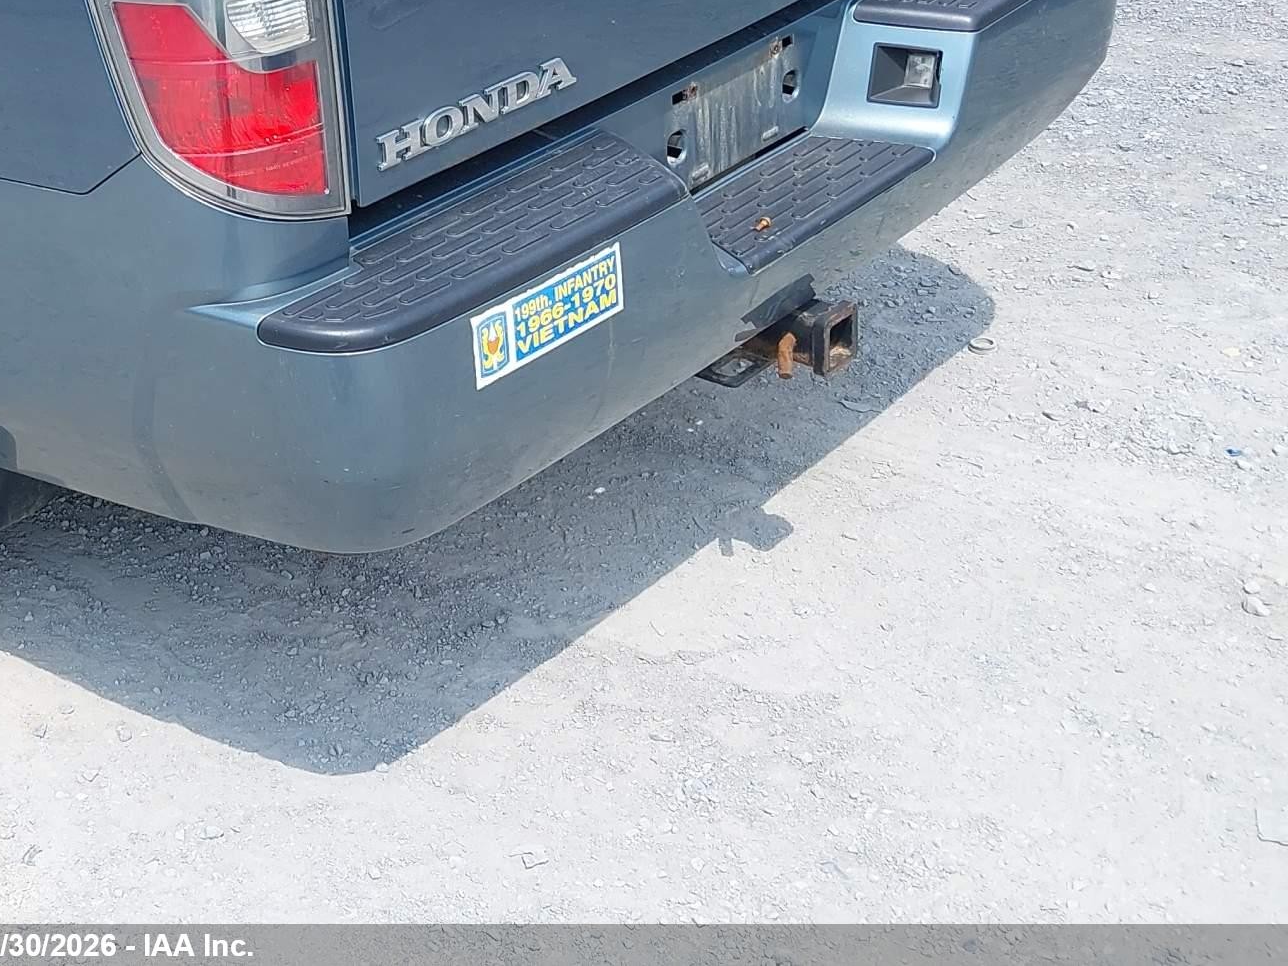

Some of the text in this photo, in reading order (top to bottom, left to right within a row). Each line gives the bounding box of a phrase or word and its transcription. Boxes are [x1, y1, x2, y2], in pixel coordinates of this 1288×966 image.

[376, 57, 577, 172] HONDA
[516, 273, 617, 338] 1966-1970
[553, 255, 616, 302] INFANTRY
[516, 288, 617, 354] VIETNAM
